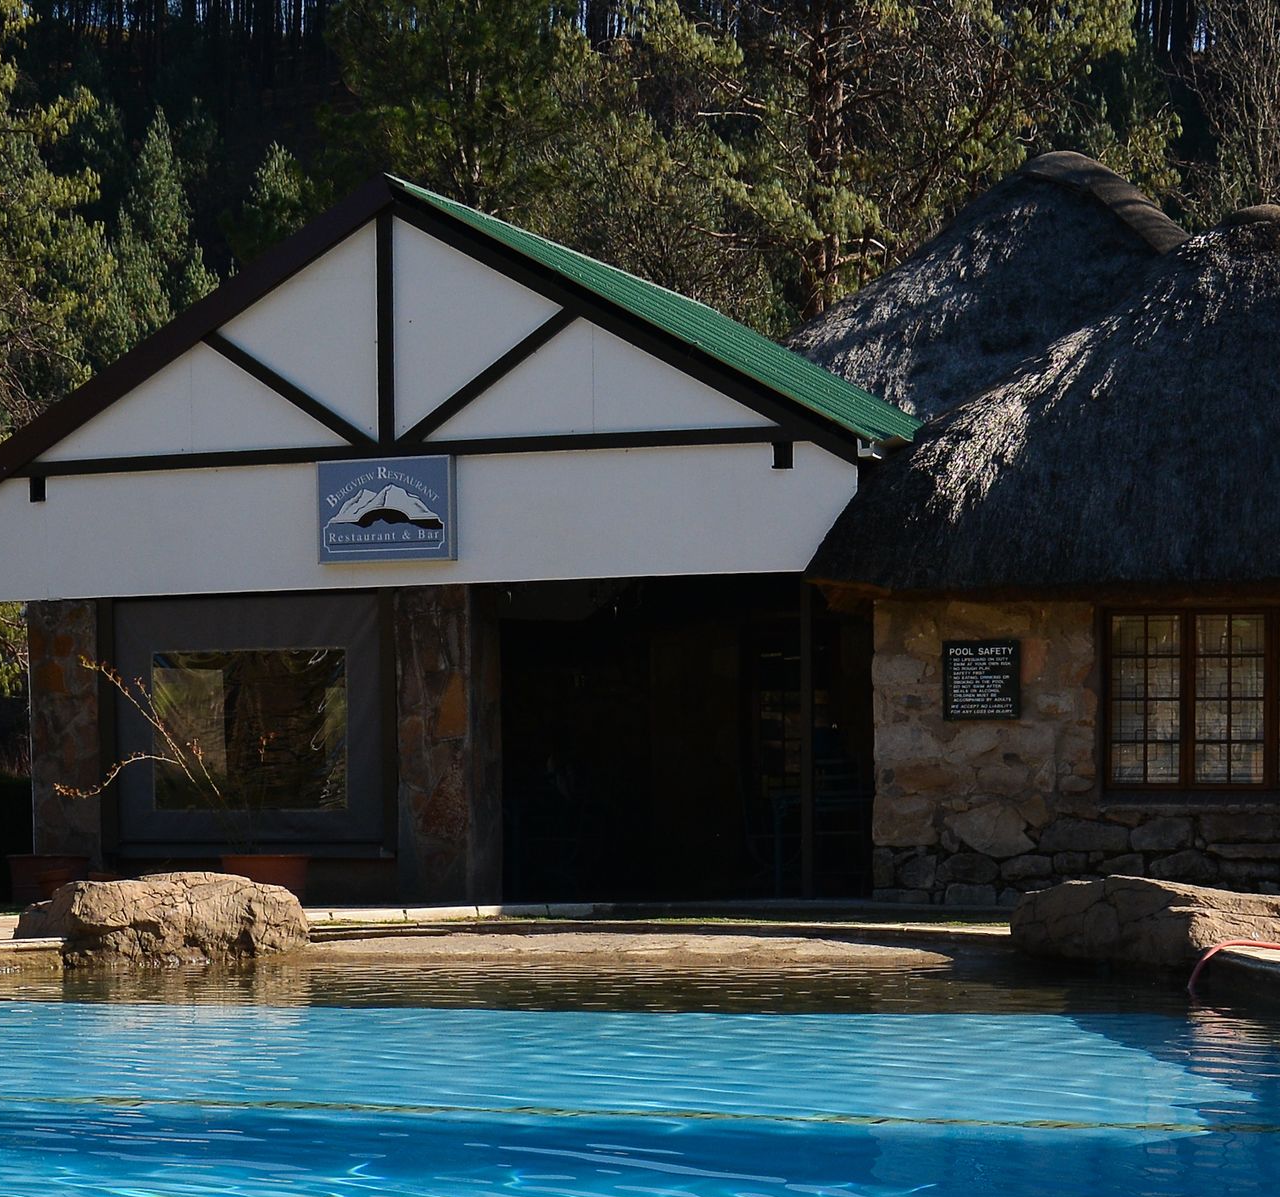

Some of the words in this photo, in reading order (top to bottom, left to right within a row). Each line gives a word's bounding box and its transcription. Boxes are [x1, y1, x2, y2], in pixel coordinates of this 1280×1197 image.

[377, 466, 439, 502] RESTAURANT
[329, 532, 395, 543] Restaurant
[402, 529, 411, 540] &
[418, 529, 439, 540] Bar
[949, 647, 974, 656] POOL
[978, 647, 1013, 655] SAFETY
